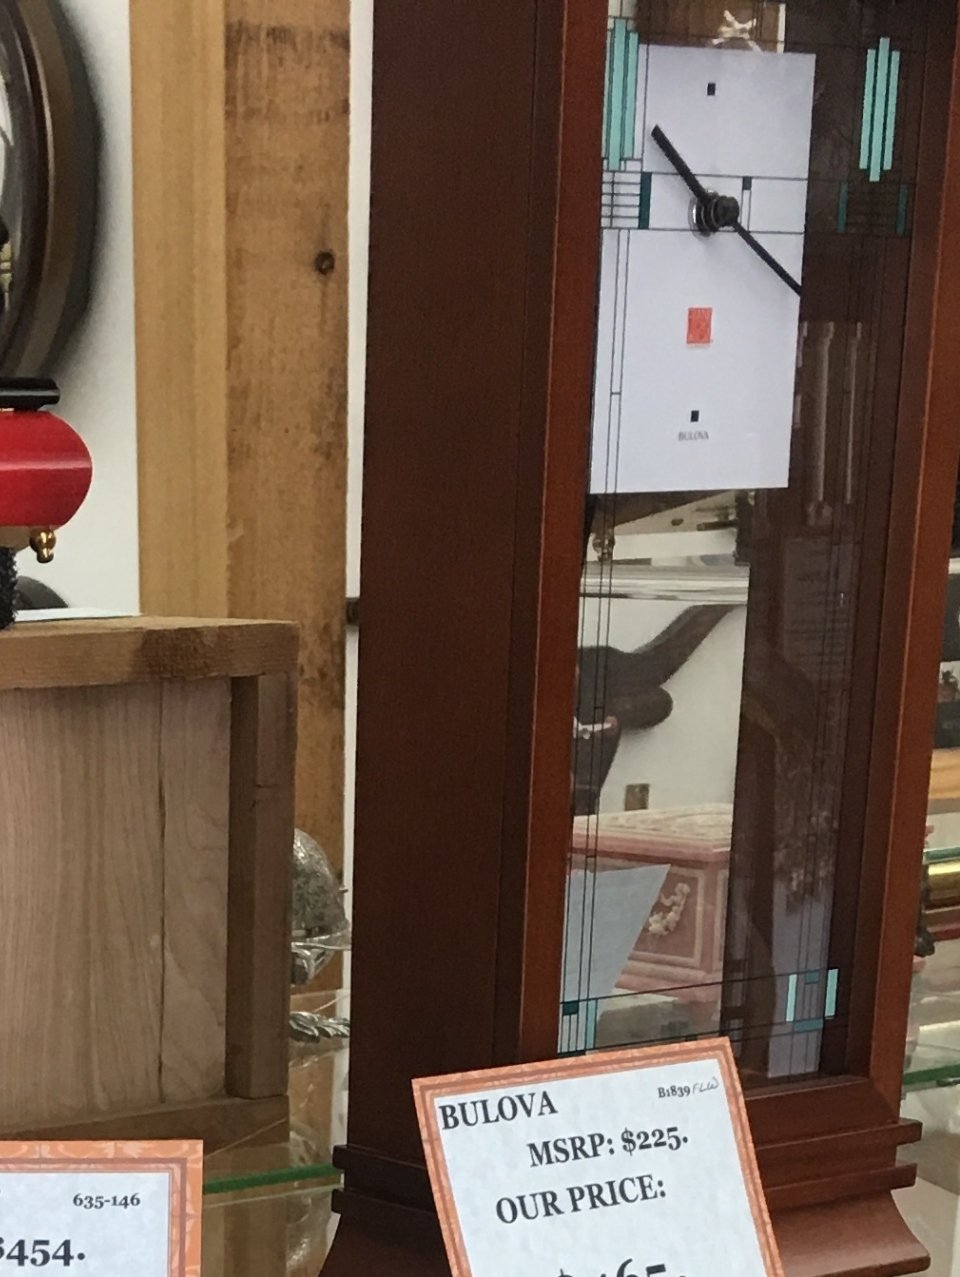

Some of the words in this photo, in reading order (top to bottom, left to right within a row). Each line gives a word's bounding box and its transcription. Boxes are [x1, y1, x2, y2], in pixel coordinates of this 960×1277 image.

[439, 1090, 559, 1130] BULOVA
[657, 1085, 691, 1098] B1839
[527, 1132, 615, 1168] MSRP:
[620, 1126, 688, 1156] $225.
[73, 1192, 141, 1210] 635-146
[496, 1190, 565, 1224] OUR
[566, 1174, 666, 1213] PRICE:
